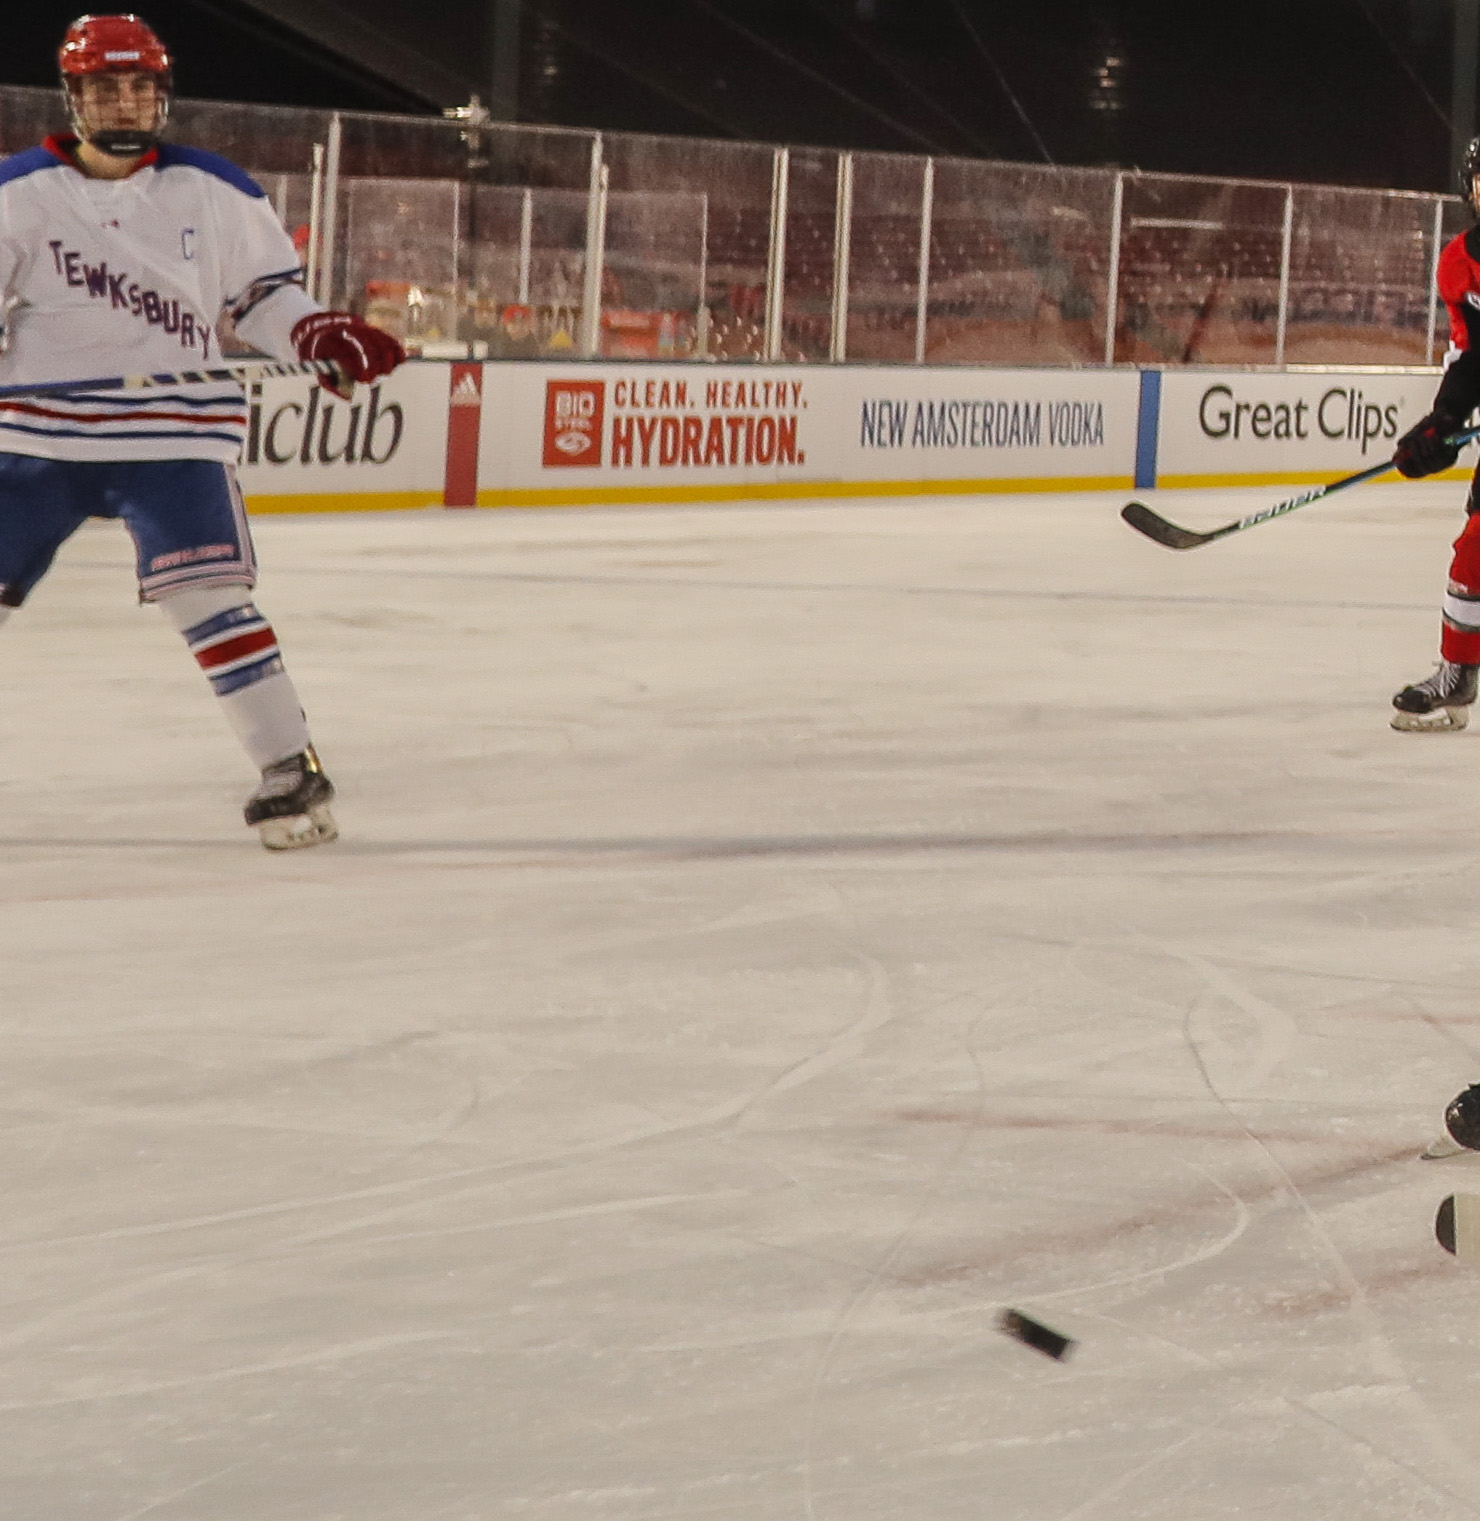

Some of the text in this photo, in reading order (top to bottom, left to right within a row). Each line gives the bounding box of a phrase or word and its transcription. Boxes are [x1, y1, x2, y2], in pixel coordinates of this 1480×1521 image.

[181, 228, 196, 260] C
[48, 240, 211, 361] TEWKSBURY
[555, 390, 595, 417] BIO
[613, 380, 808, 409] CLEAN. HEALTHY.
[1199, 384, 1399, 454] Great Clips
[240, 382, 405, 466] iclub
[611, 416, 806, 467] HYDRATION.
[859, 400, 1104, 449] NEW AMSTERDAM VODKA
